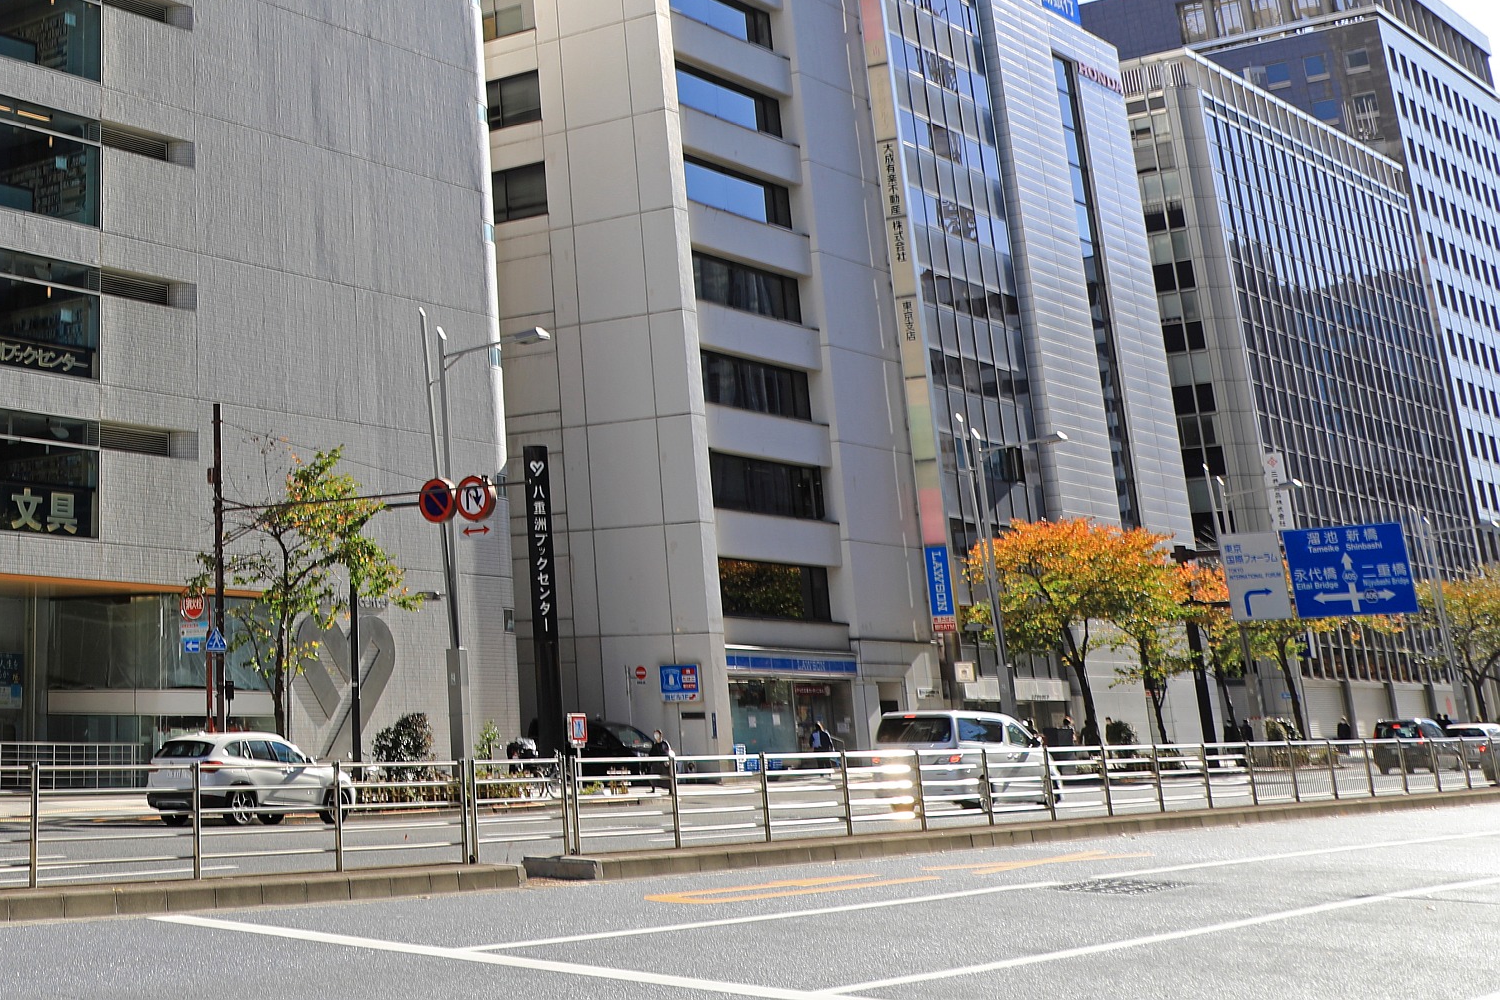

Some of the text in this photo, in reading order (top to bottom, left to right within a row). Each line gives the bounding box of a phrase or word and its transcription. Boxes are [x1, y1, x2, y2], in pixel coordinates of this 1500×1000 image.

[1078, 62, 1123, 94] HONDA
[902, 301, 916, 341] 東京支店
[11, 487, 77, 535] 文具
[1307, 528, 1378, 546] 溜池 新橋
[1224, 544, 1241, 553] 東京
[1308, 542, 1382, 554] Tameike Shinbashi
[533, 485, 550, 632] 八重洲ブックセンター
[1226, 553, 1278, 565] 国際フォーラム
[1294, 567, 1337, 582] 永代橋
[1344, 573, 1356, 581] 405
[1362, 562, 1407, 578] 二重橋
[931, 551, 948, 612] LAWSON
[1315, 581, 1338, 590] Bridge
[797, 660, 826, 672] LAWSON
